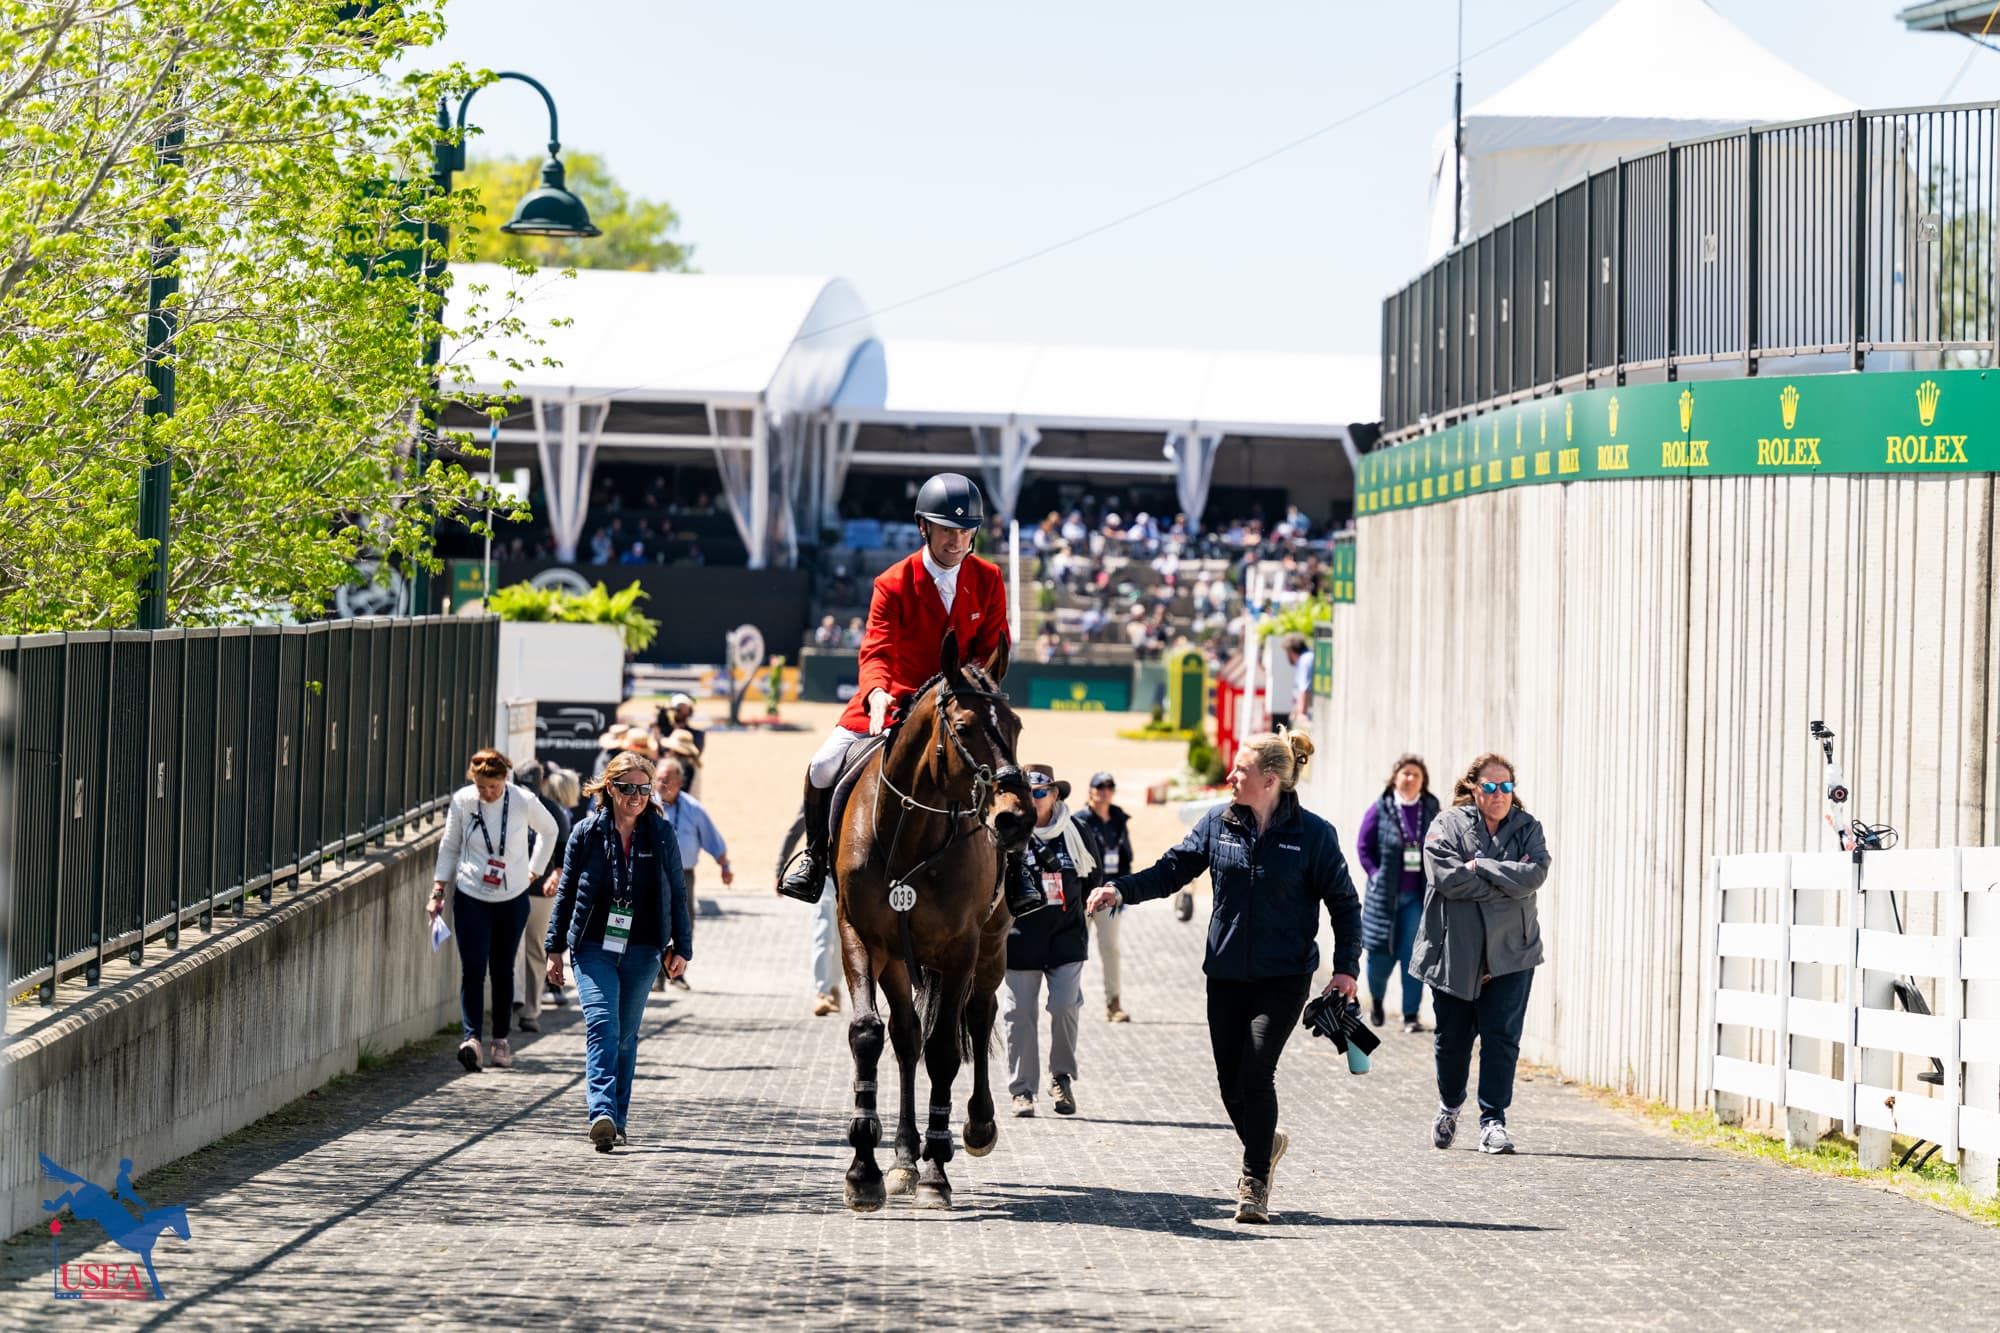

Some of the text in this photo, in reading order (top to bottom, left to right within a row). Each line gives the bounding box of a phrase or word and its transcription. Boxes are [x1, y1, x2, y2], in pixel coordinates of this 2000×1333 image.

[1597, 444, 1629, 471] ROLEX
[1661, 440, 1709, 467] ROLEX
[1757, 438, 1821, 465] ROLEX
[1886, 435, 1968, 464] ROLEX
[536, 738, 600, 749] EFENDER
[893, 891, 912, 906] 039
